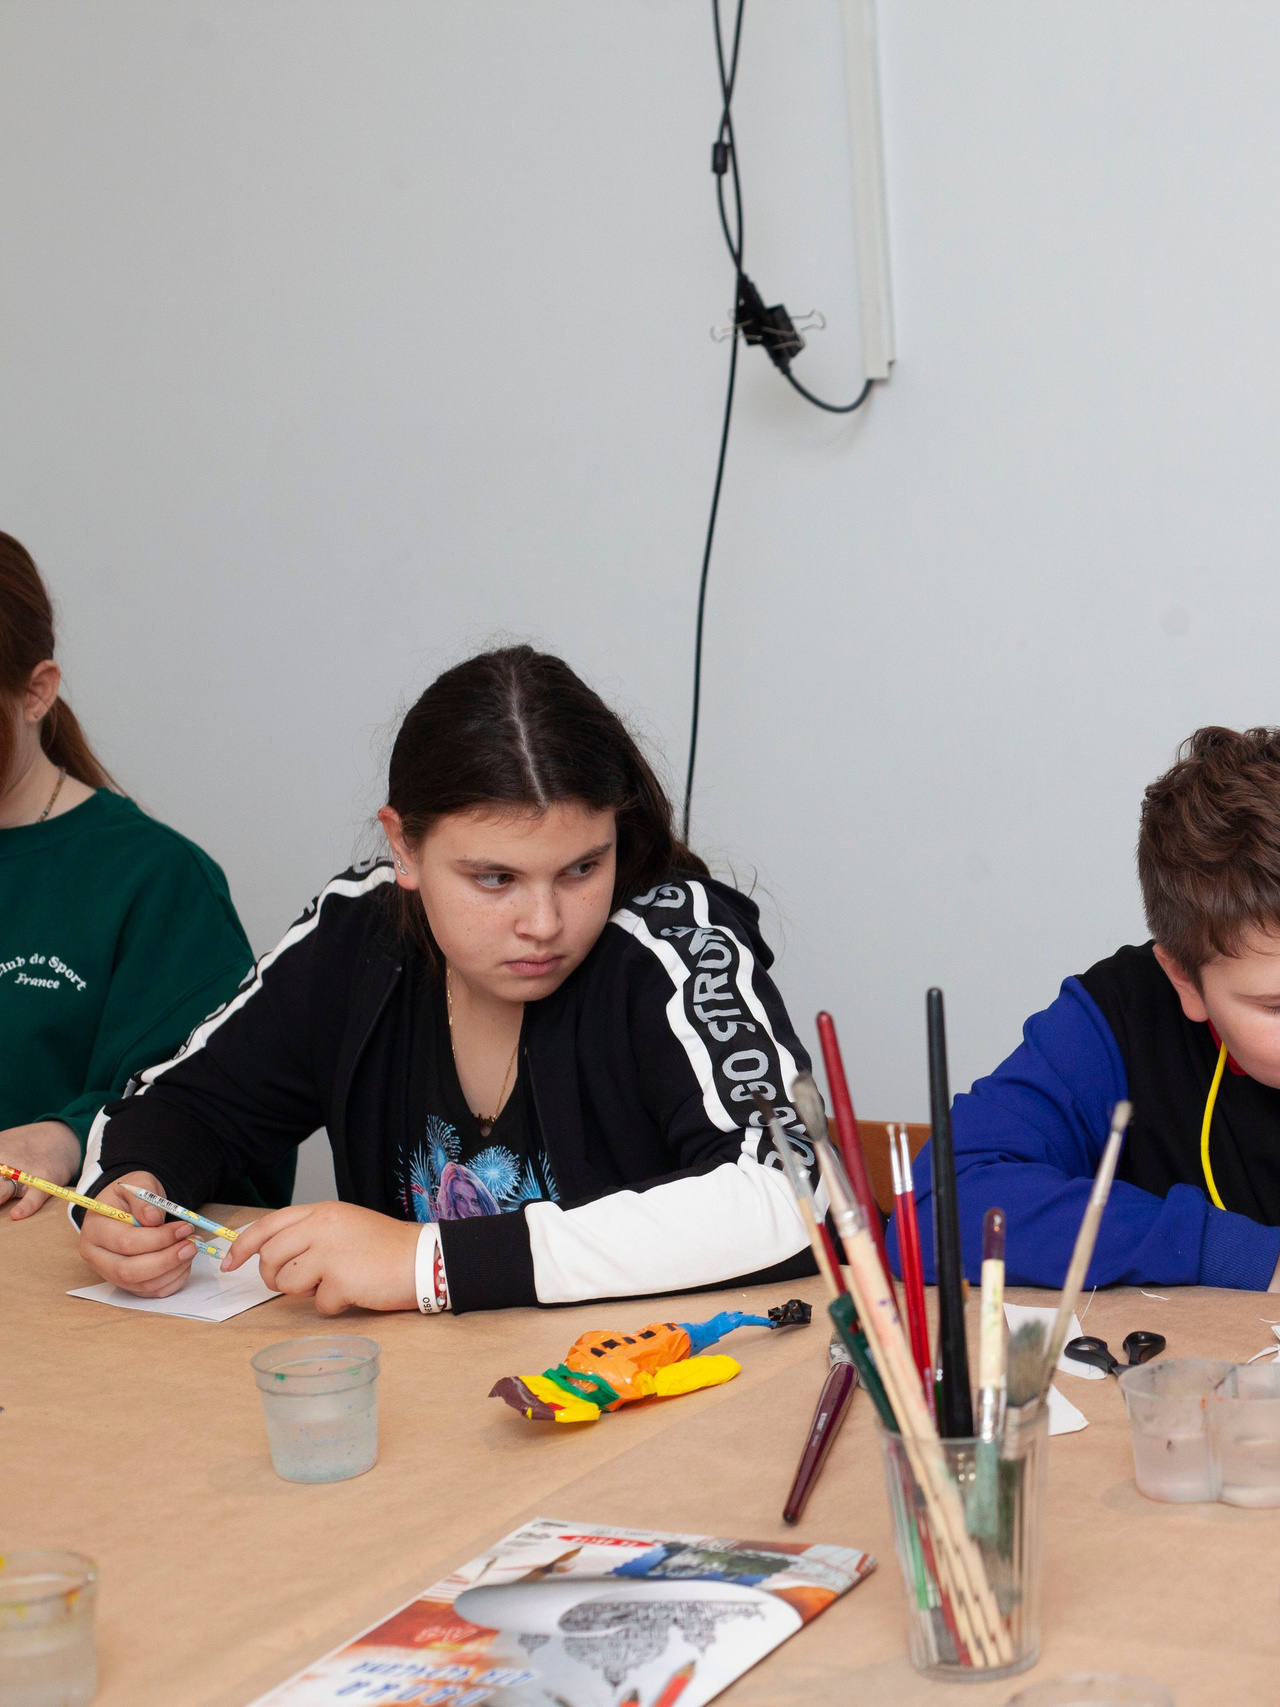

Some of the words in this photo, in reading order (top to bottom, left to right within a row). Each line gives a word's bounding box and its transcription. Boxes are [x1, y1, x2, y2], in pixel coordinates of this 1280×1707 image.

[14, 972, 60, 989] France
[29, 953, 46, 965] de
[48, 956, 87, 992] Sport
[721, 1049, 777, 1102] GO
